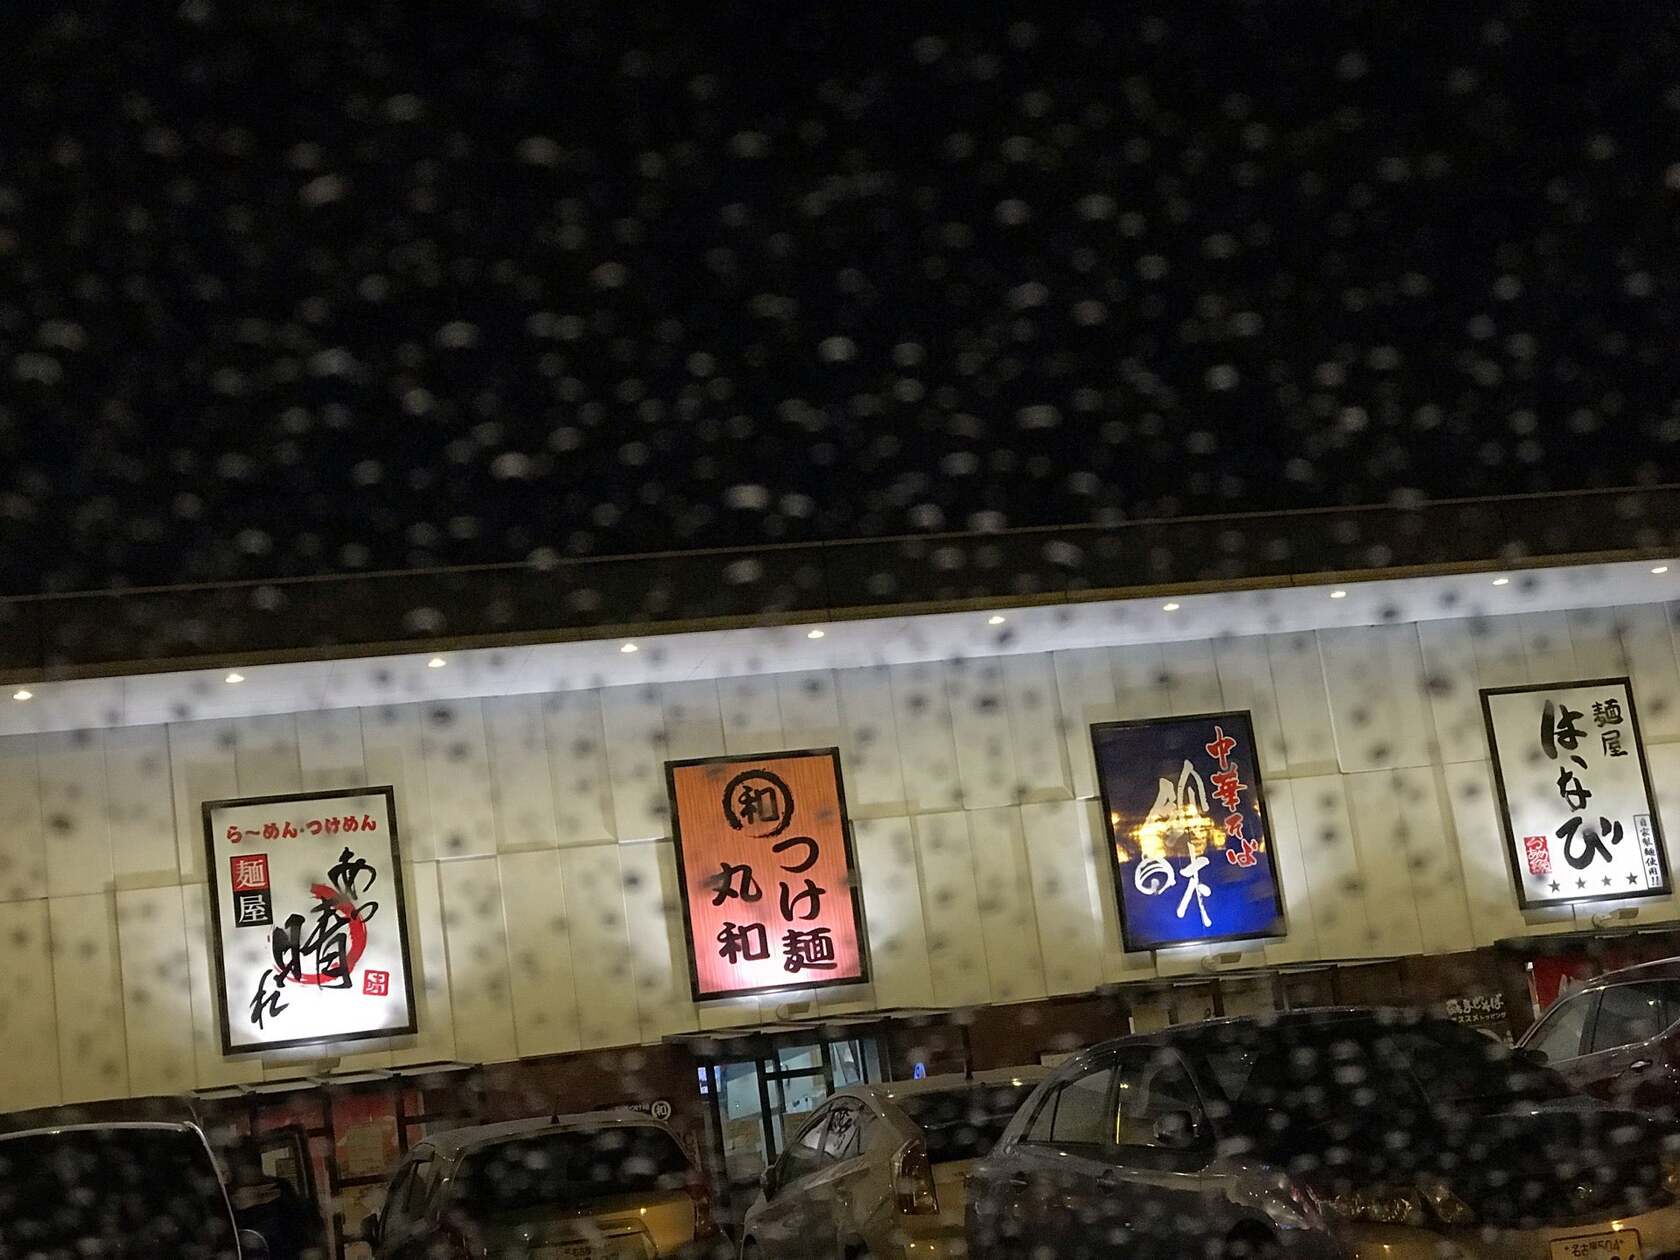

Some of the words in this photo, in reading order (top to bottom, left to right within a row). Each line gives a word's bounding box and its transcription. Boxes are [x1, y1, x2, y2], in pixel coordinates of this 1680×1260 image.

[1540, 700, 1624, 869] はなび
[1592, 698, 1628, 757] 麺屋
[1205, 725, 1258, 867] 中華そば
[236, 857, 270, 925] 麺屋
[711, 861, 771, 964] 丸和
[772, 836, 838, 974] つけ麺
